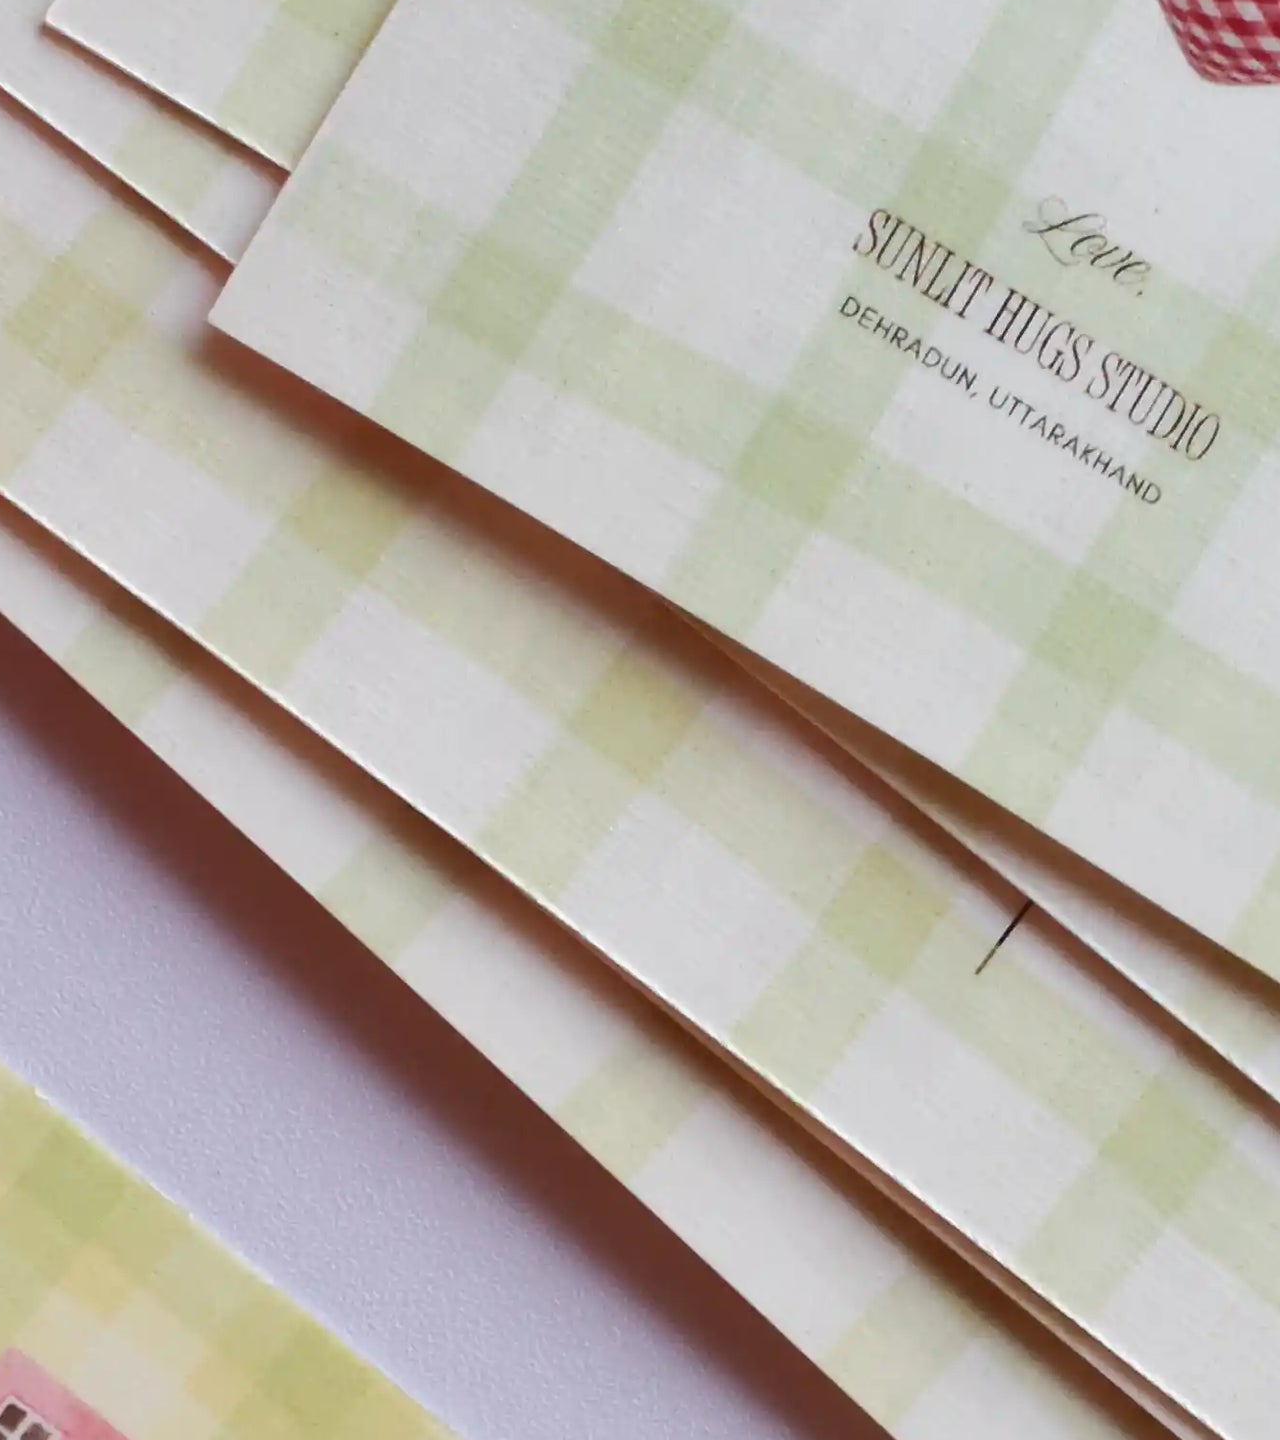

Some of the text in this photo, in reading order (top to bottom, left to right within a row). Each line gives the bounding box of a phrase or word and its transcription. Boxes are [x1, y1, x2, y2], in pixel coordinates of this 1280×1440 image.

[838, 295, 1162, 505] DEHRADUN, UTTARAKHAND
[851, 208, 1221, 462] SUNLIT HUGS STUDIO
